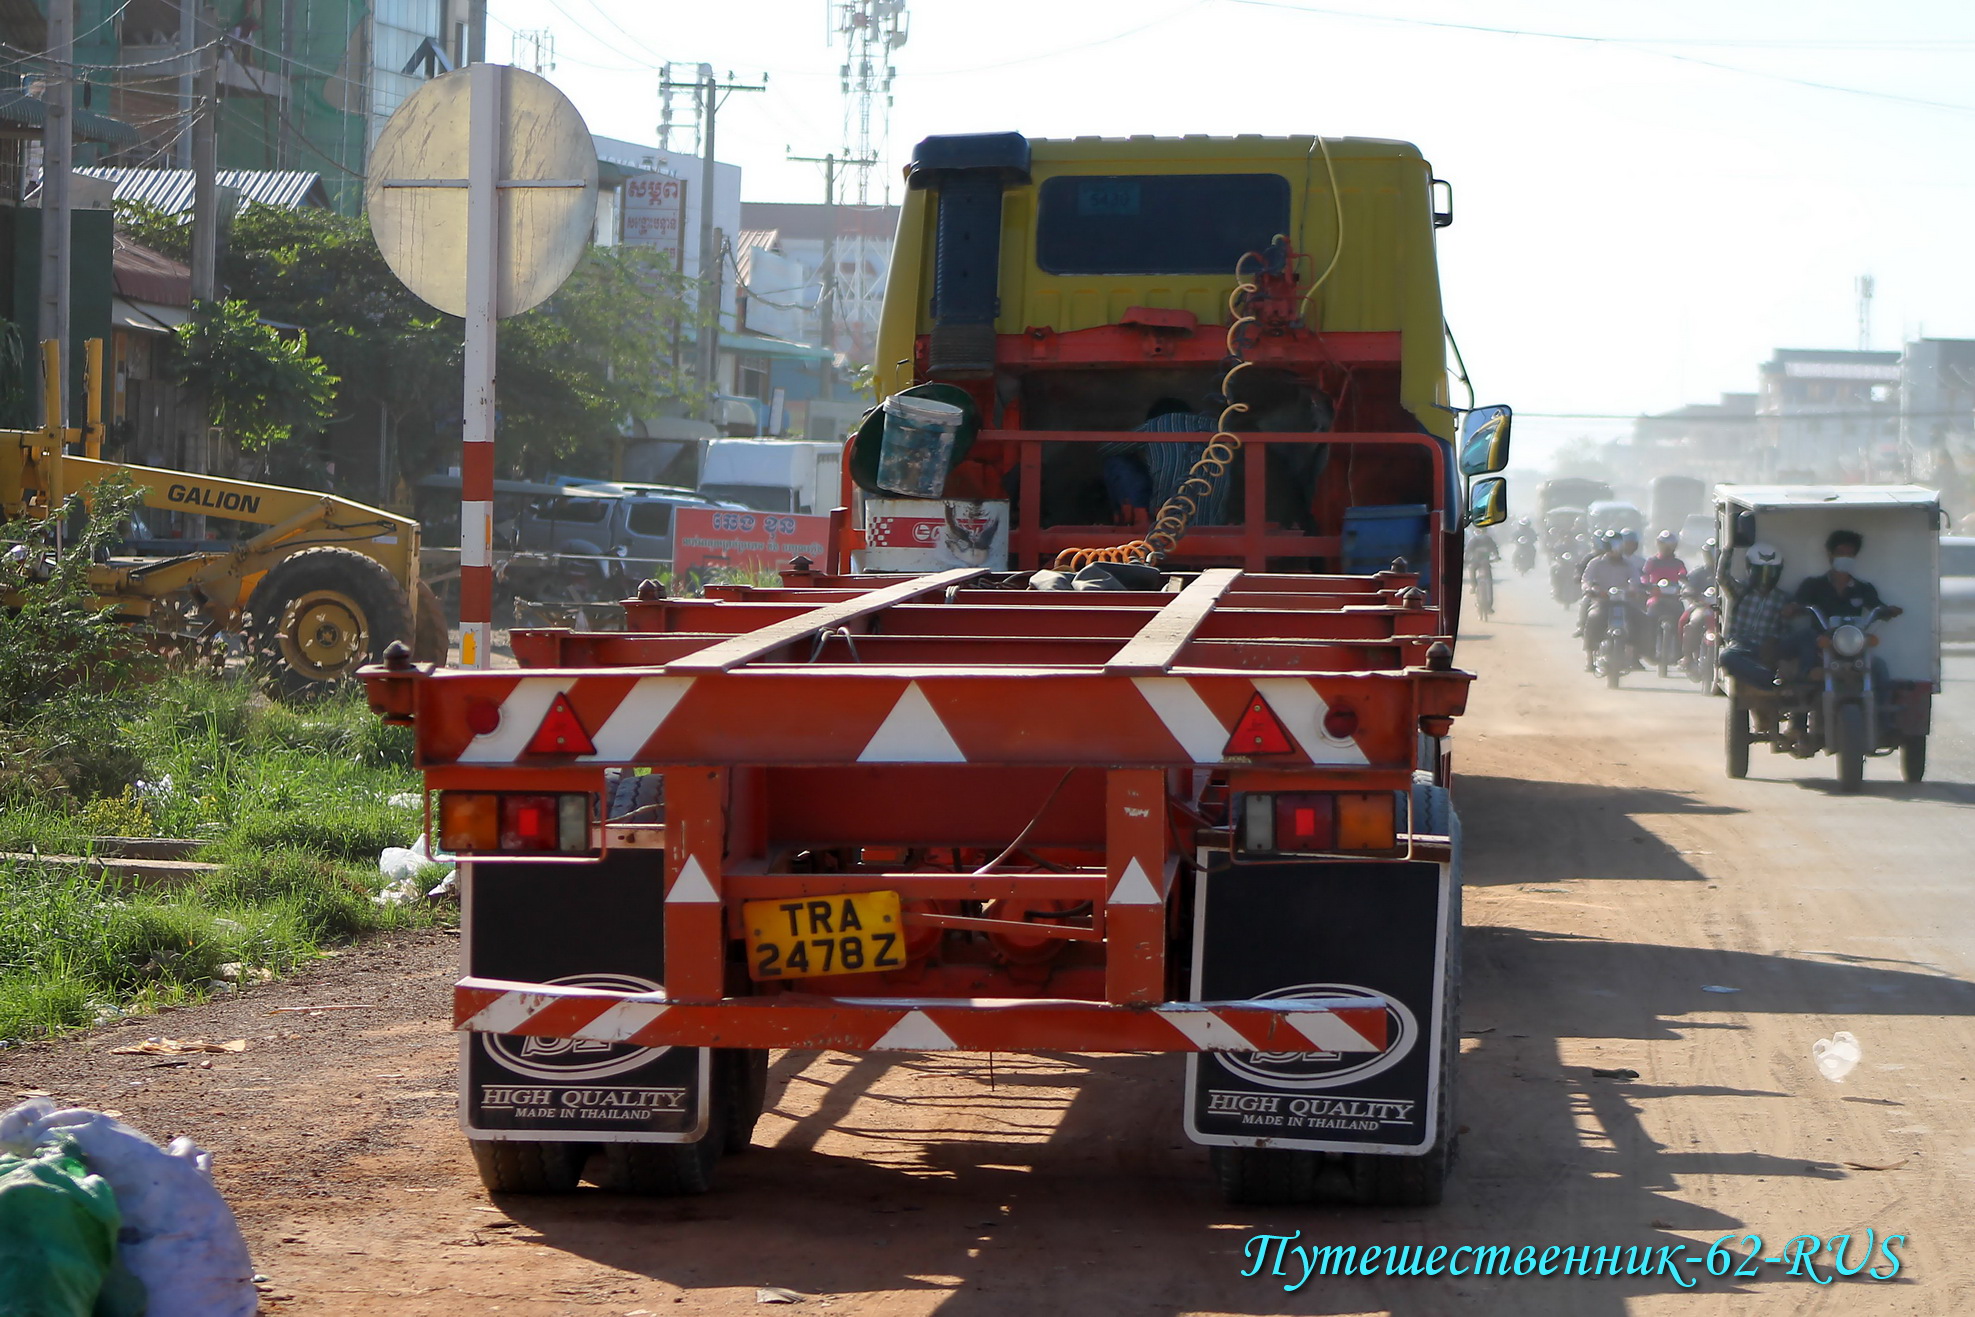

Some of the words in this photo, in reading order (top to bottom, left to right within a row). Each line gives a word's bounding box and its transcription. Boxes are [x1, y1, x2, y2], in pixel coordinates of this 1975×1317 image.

[167, 484, 261, 513] GALION
[779, 898, 862, 936] TRA
[481, 1088, 552, 1105] HIGH
[561, 1089, 685, 1108] QUALITY
[1208, 1093, 1281, 1113] HIGH
[1289, 1099, 1414, 1120] QUALITY
[515, 1107, 555, 1118] MADE
[560, 1108, 575, 1118] IN
[580, 1108, 651, 1120] THAILAND
[1242, 1114, 1284, 1126] MADE
[1287, 1116, 1304, 1127] IN
[1307, 1117, 1380, 1131] THAILAND
